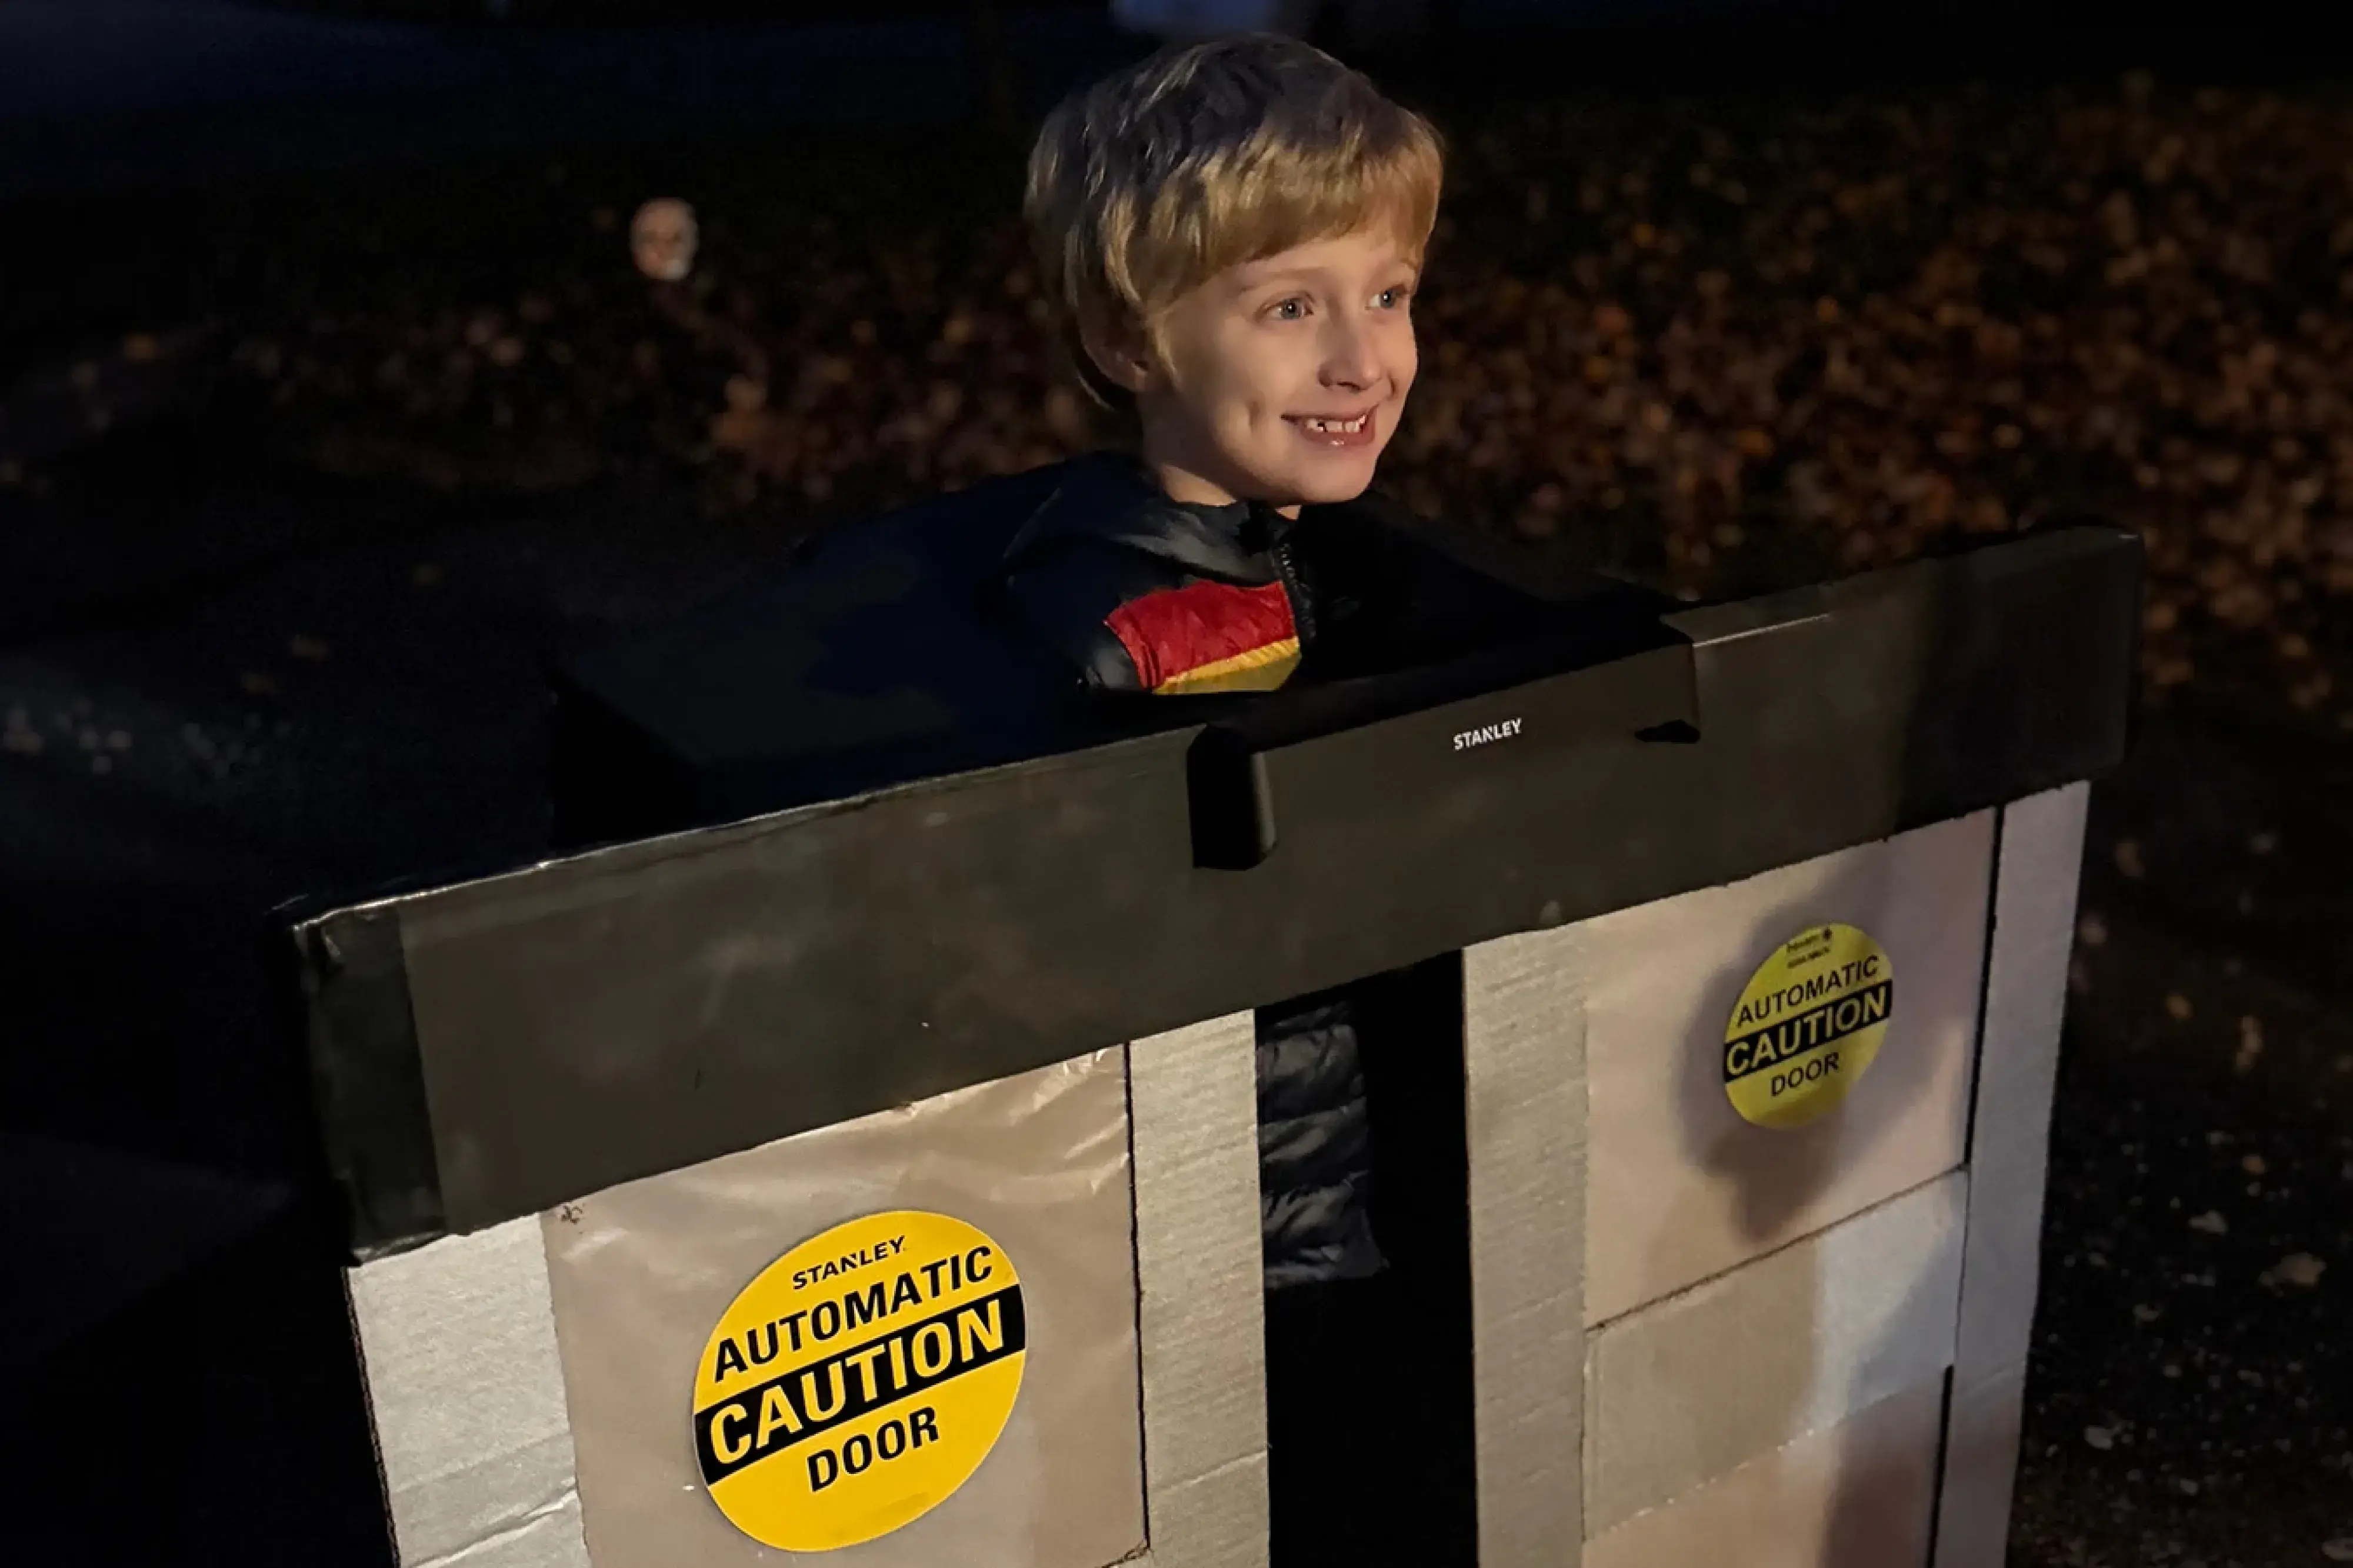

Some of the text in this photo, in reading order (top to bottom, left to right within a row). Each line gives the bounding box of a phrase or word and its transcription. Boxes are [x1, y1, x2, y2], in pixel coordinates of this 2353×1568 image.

[1454, 718, 1522, 751] STANLEY
[1727, 985, 1887, 1076] CAUTION
[1737, 955, 1879, 1028] AUTOMATIC
[1771, 1052, 1839, 1097] DOOR
[792, 1235, 905, 1290] STANLEY
[714, 1245, 992, 1382] AUTOMATIC
[710, 1298, 1004, 1464] CAUTION
[806, 1407, 939, 1493] DOOR
